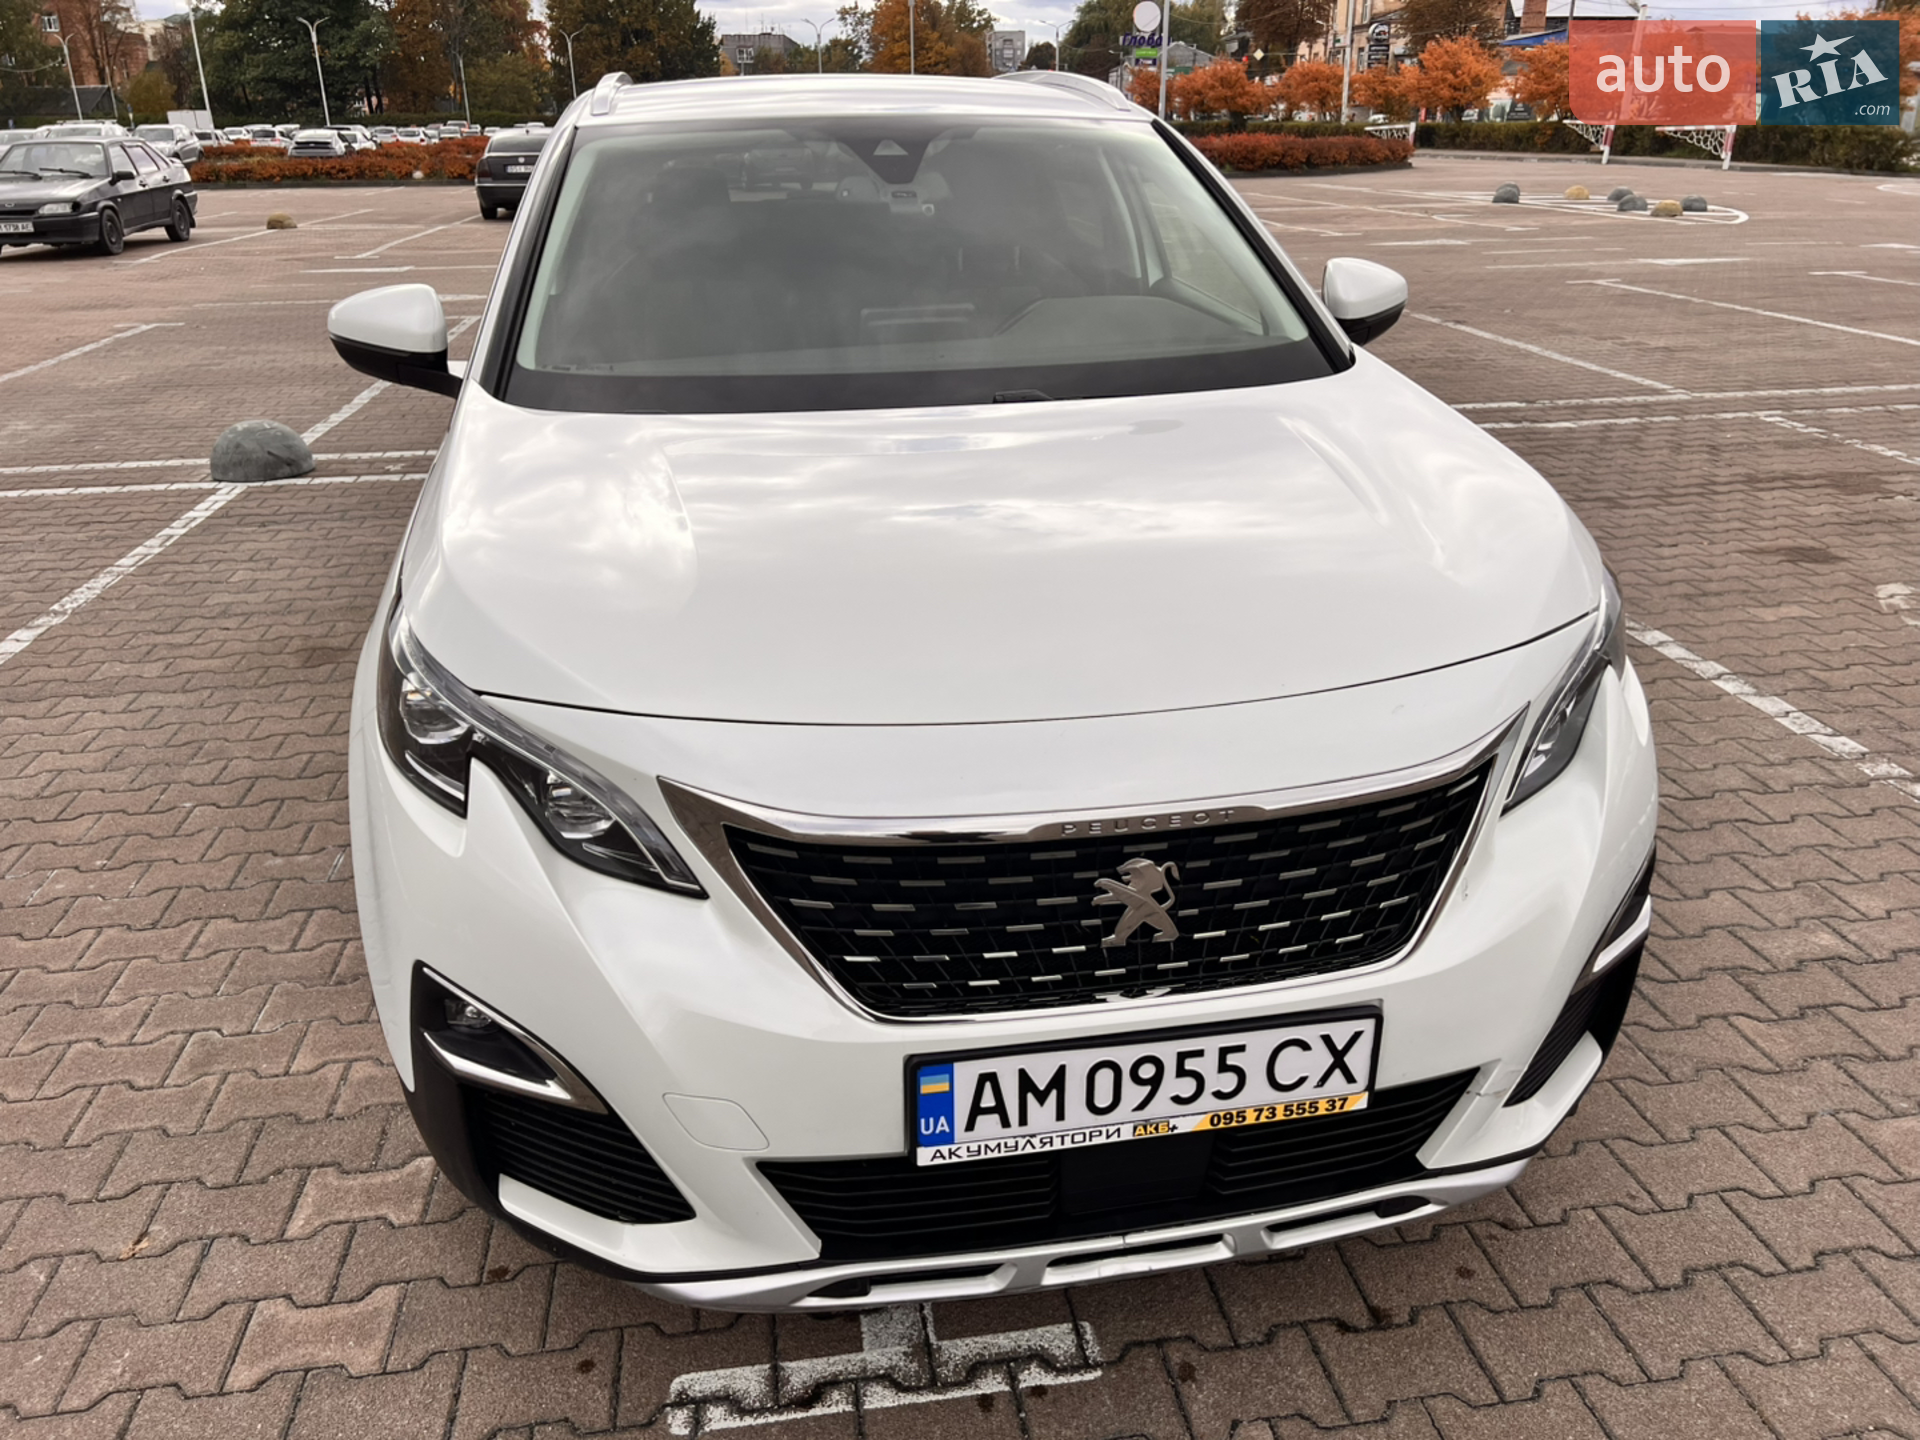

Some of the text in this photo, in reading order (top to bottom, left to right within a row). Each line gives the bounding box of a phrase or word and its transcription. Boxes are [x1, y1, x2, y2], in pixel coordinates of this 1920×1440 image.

[1061, 809, 1235, 837] PEUGEOT
[964, 1030, 1364, 1132] AM 0955 CX
[920, 1116, 950, 1135] UA
[930, 1127, 1121, 1162] АКУМУЛЯТОРИ
[1209, 1111, 1247, 1127] 095
[1253, 1106, 1277, 1121] 73
[1282, 1101, 1319, 1118] 555
[1325, 1097, 1348, 1112] 37
